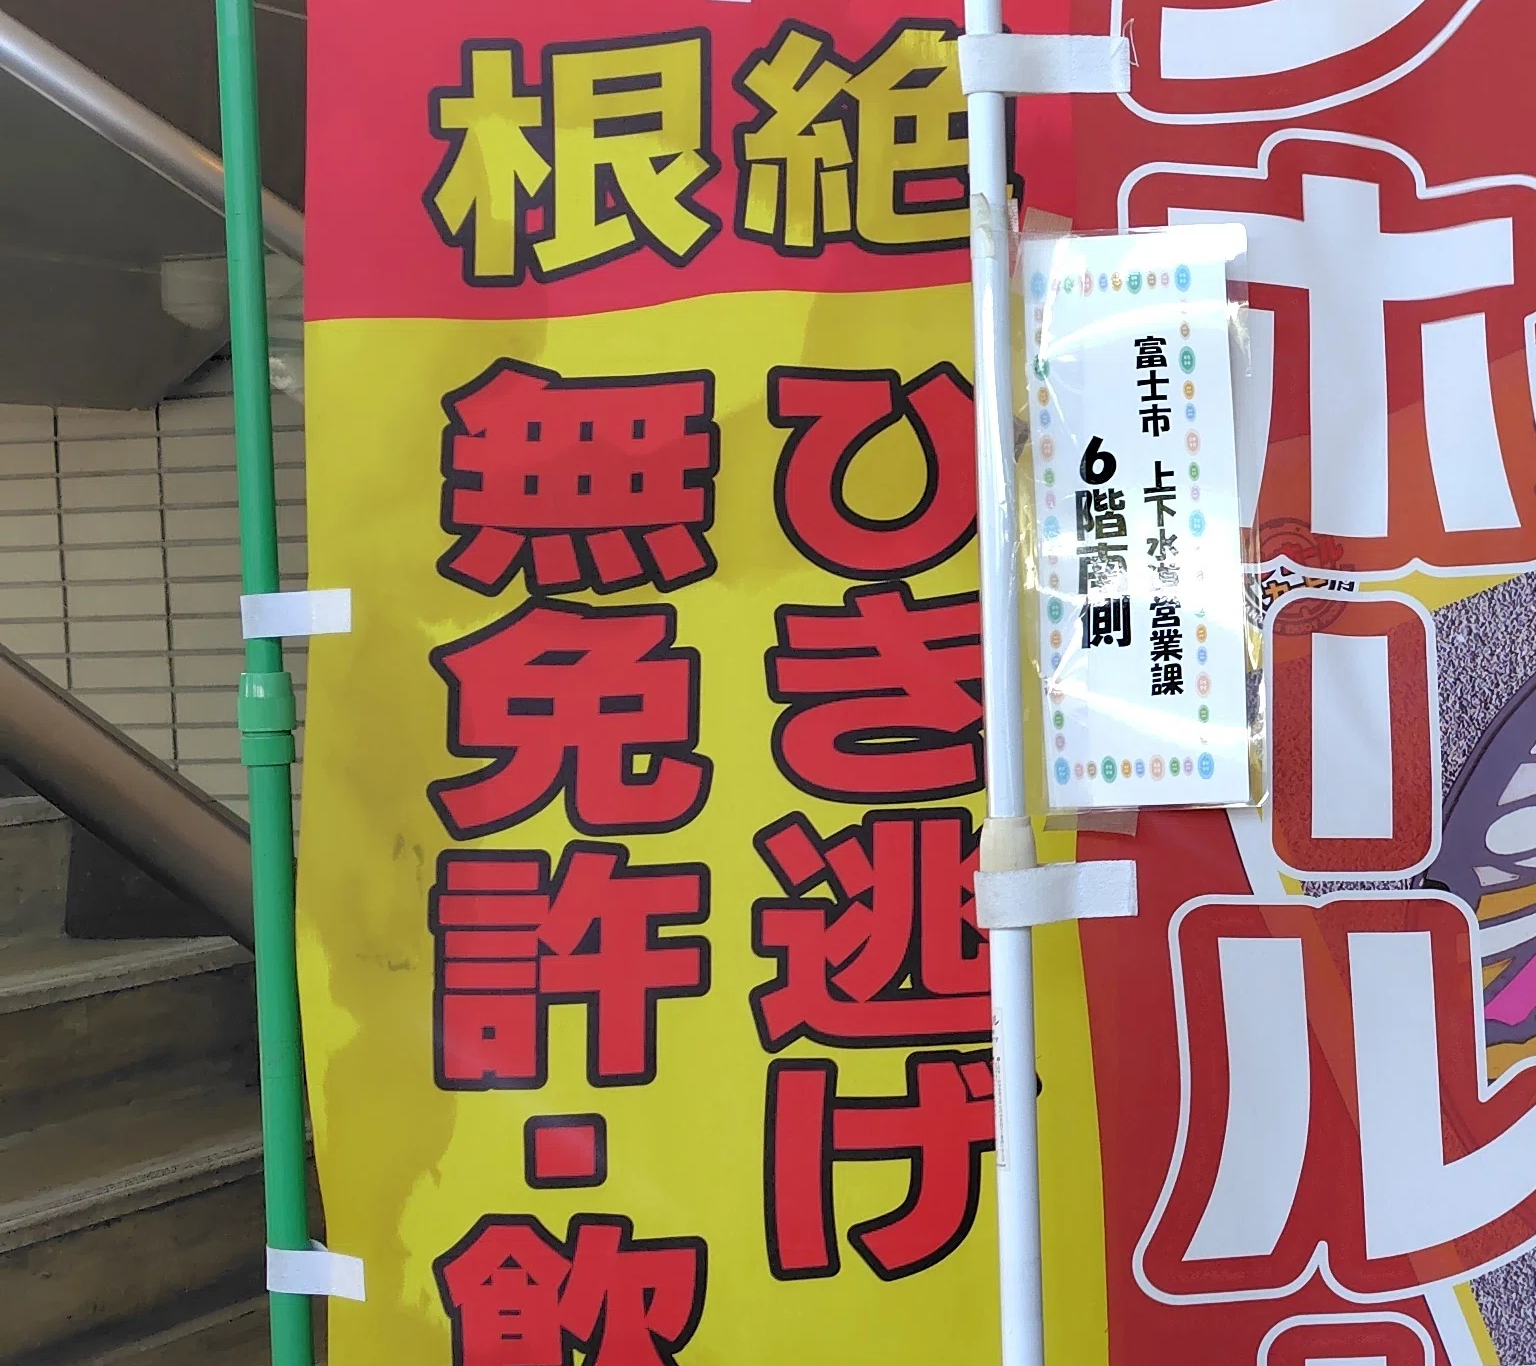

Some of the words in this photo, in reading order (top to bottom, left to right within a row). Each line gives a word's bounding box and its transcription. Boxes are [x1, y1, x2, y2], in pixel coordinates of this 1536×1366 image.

[428, 21, 1020, 283] 根絶
[1133, 335, 1173, 437] 富士市
[750, 357, 995, 1281] ひき逃げ
